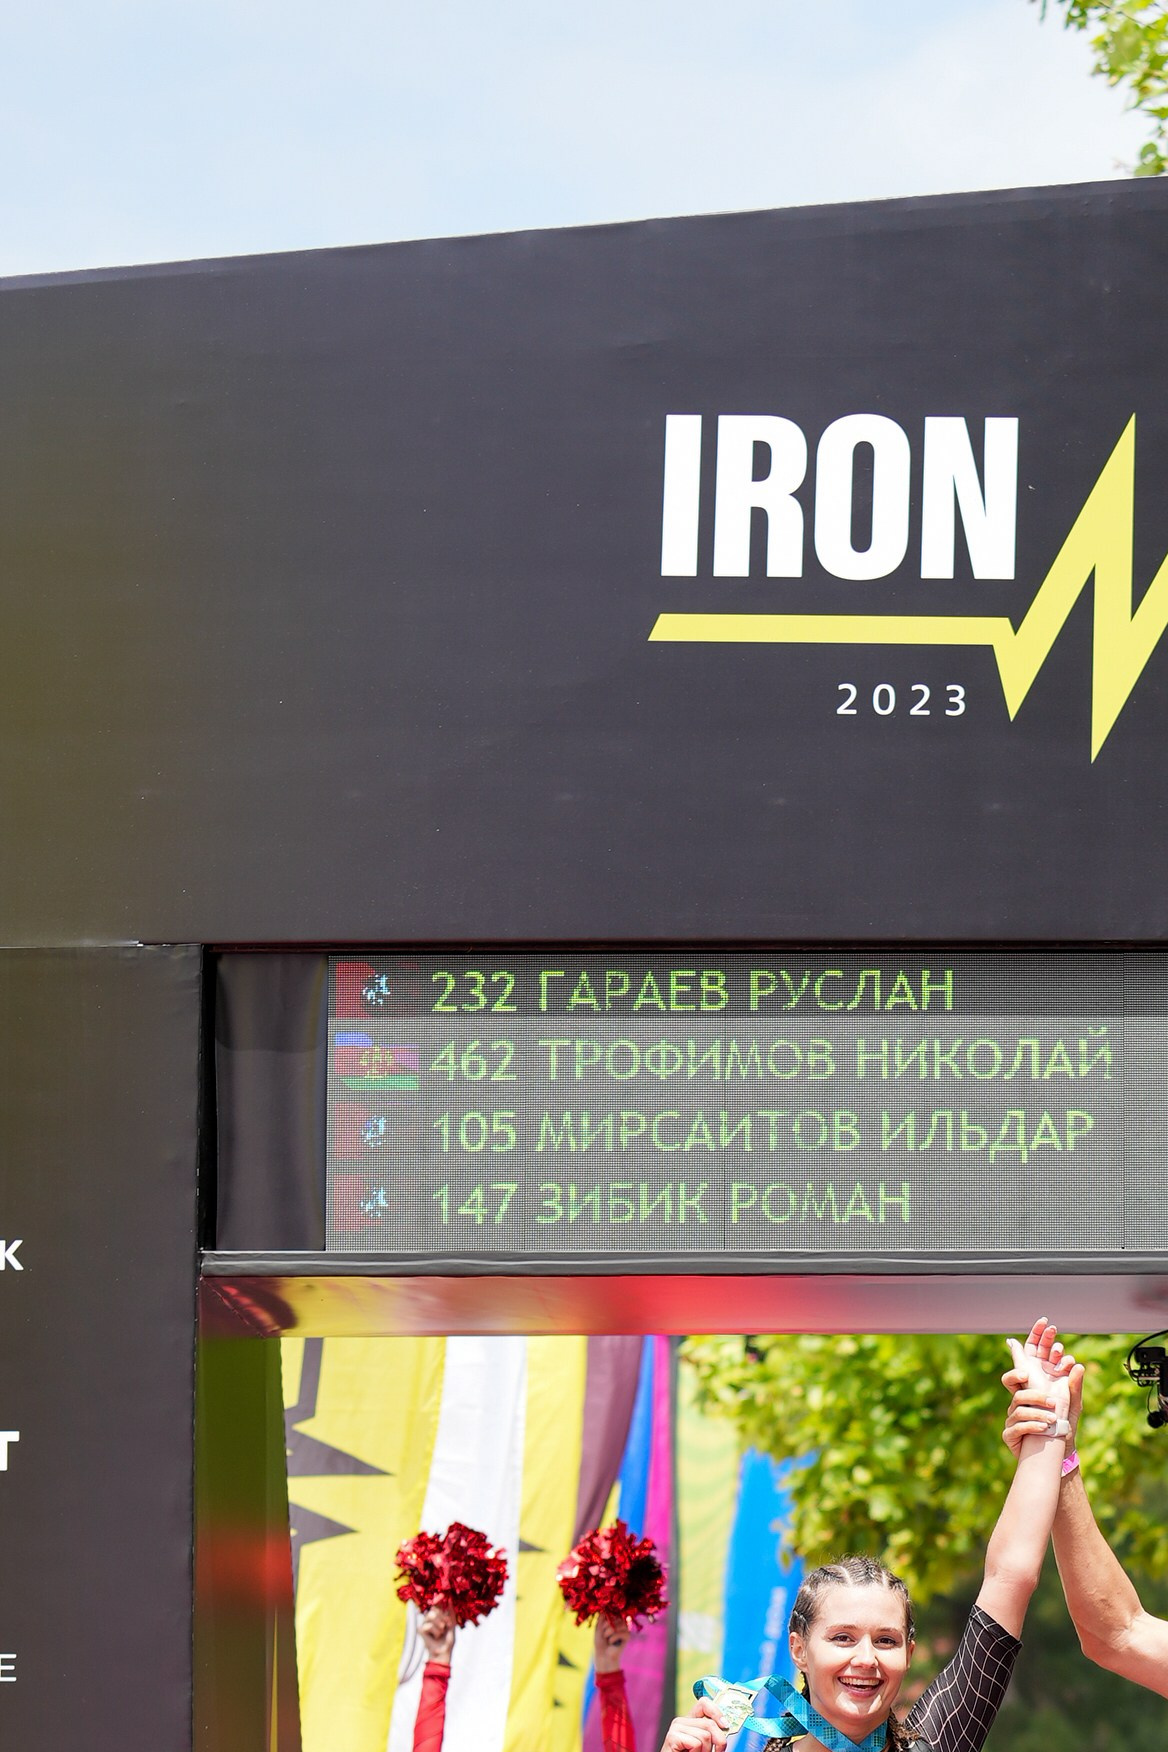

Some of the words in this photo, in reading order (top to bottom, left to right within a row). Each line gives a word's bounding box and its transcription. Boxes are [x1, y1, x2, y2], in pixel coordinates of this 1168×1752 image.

[661, 414, 1018, 580] IRON
[836, 683, 967, 716] 2023
[432, 969, 517, 1012] 232
[538, 969, 728, 1011] ГАРАЕВ
[750, 968, 955, 1011] РУСЛАН
[428, 1038, 517, 1081] 462
[538, 1037, 835, 1080] ТРОФИМОВ
[855, 1026, 1113, 1080] НИКОЛАЙ
[433, 1109, 517, 1152] 105
[535, 1109, 860, 1152] МИРСАИТОВ
[881, 1109, 1095, 1163] ИЛЬДАР
[433, 1181, 518, 1225] 147
[536, 1180, 709, 1224] ЗИБИК
[731, 1180, 911, 1224] РОМАН
